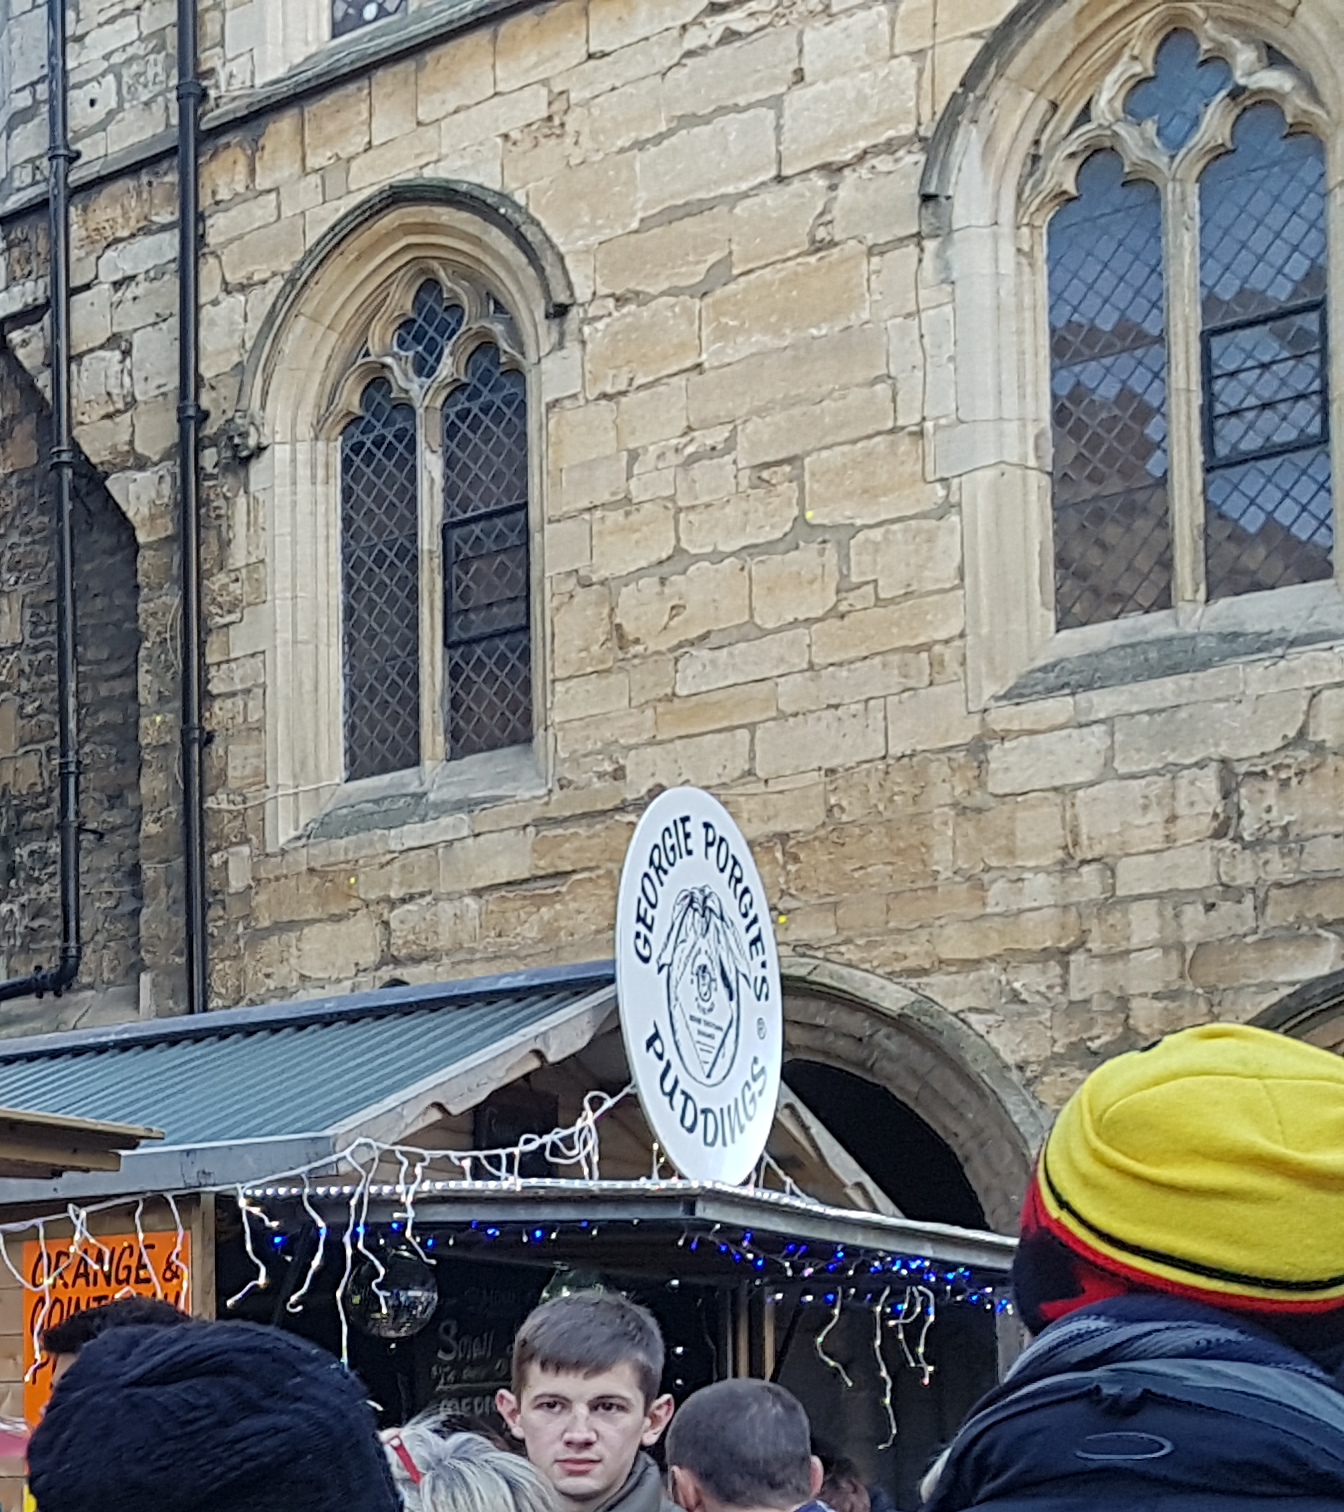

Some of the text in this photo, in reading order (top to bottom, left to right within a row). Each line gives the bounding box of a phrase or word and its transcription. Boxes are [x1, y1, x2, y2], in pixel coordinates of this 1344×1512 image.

[633, 814, 770, 1003] GEORGIE PORGIE'S
[645, 1020, 767, 1148] PUDDINGS
[31, 1243, 181, 1289] ORANGE &
